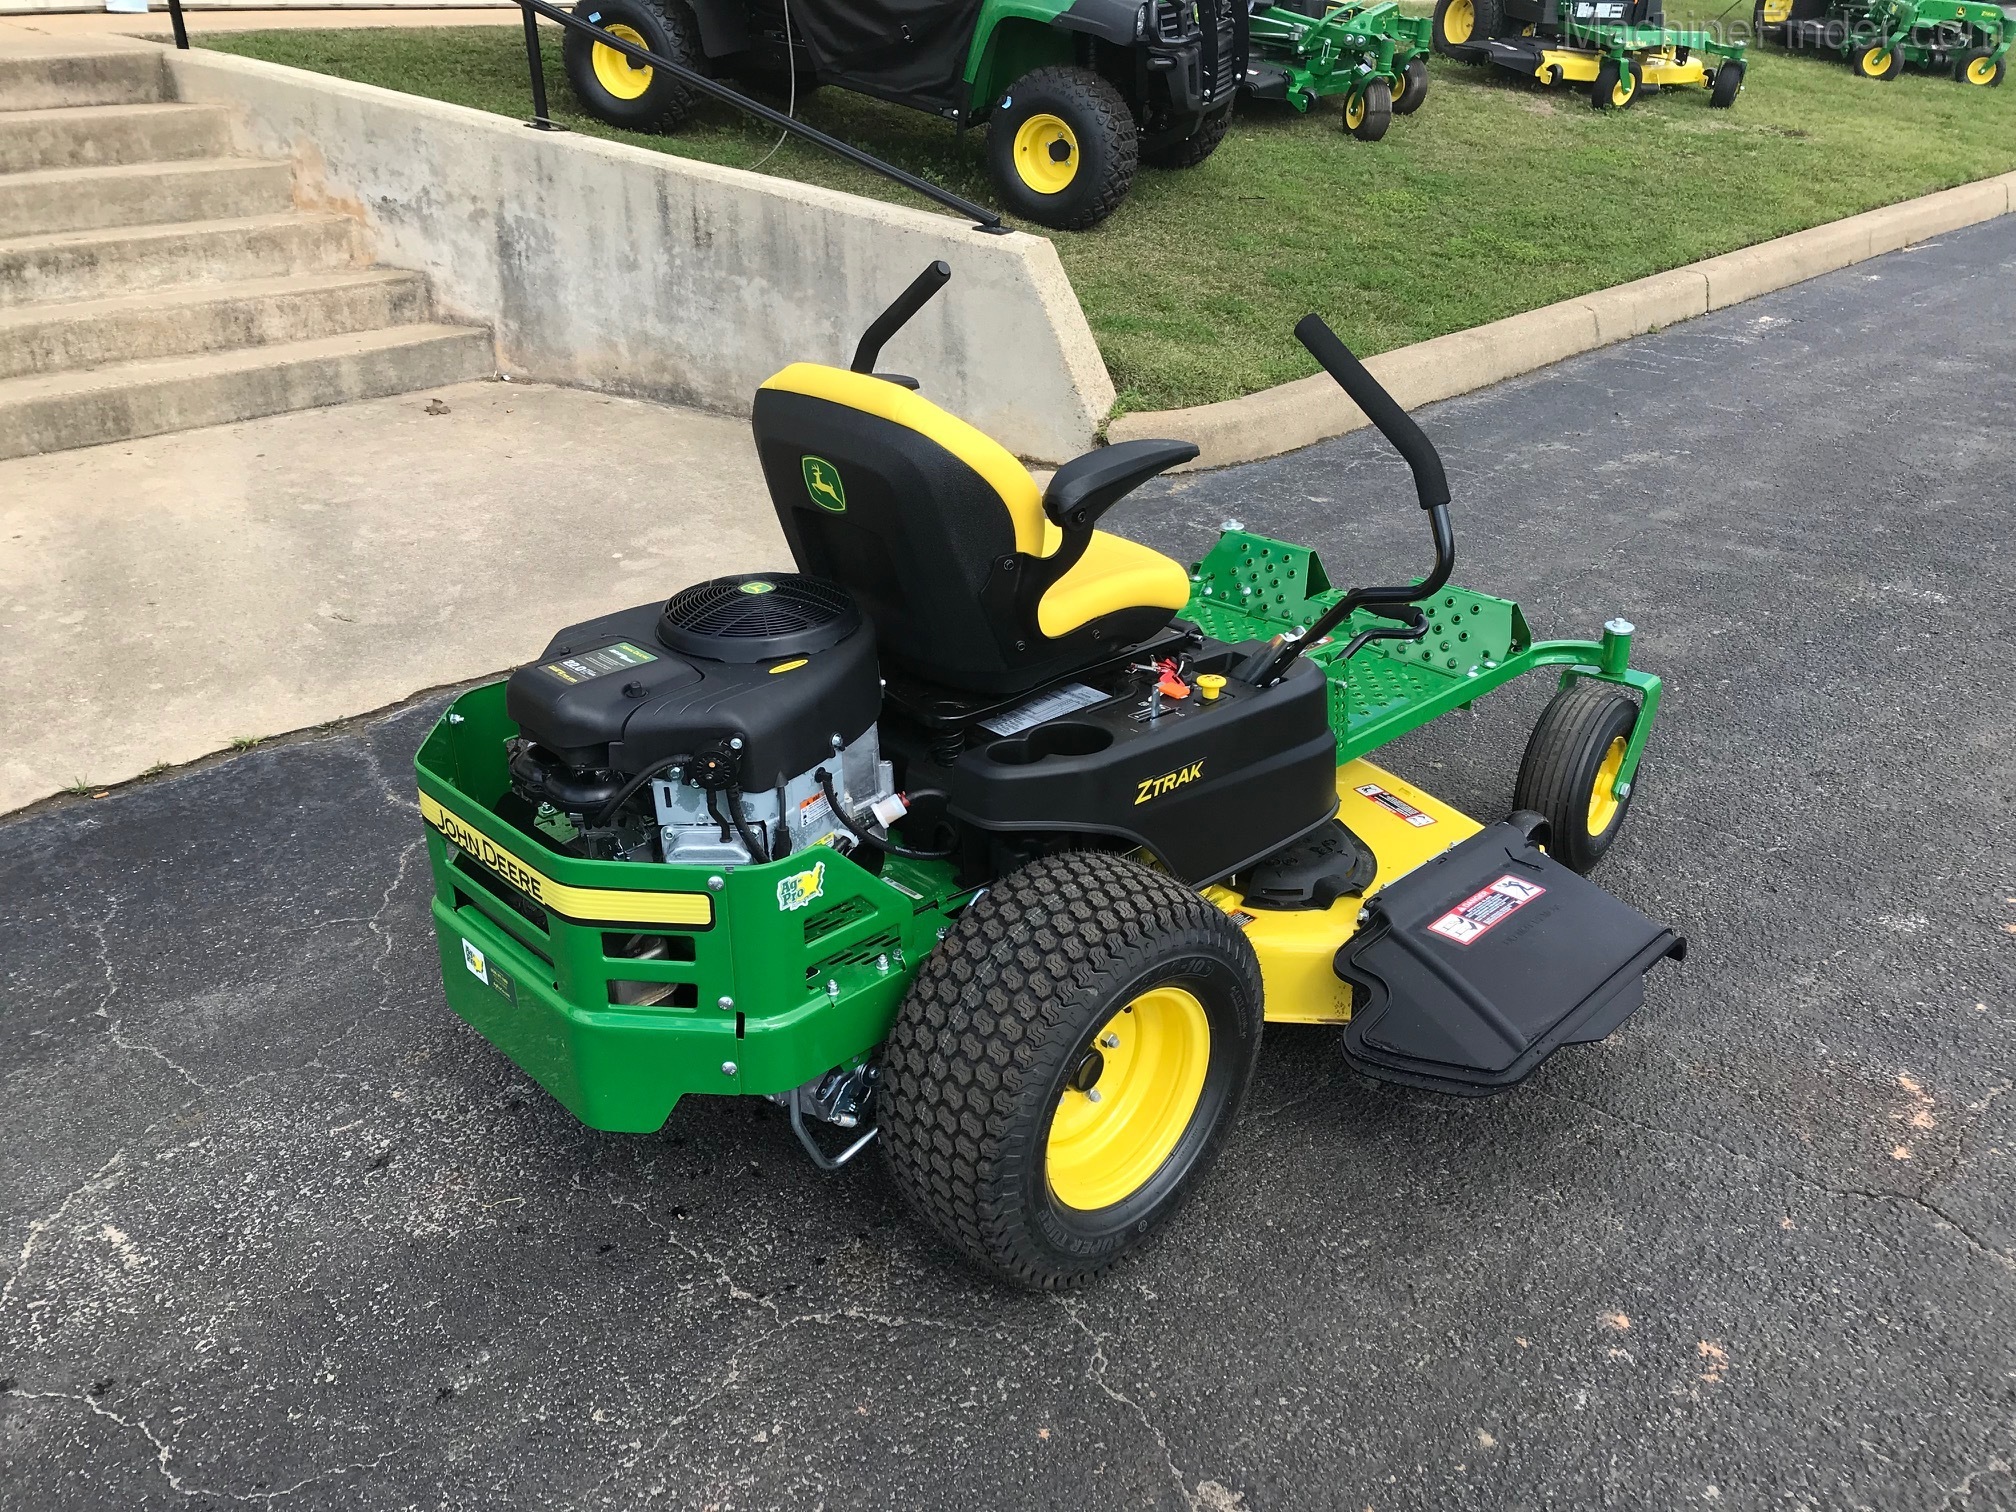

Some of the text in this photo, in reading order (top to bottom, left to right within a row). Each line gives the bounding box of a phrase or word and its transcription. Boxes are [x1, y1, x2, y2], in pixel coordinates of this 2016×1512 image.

[1134, 761, 1204, 805] ZTRAK
[438, 810, 543, 901] JOHN DEERE
[782, 889, 803, 906] Pro
[1069, 1231, 1126, 1254] SUPER
